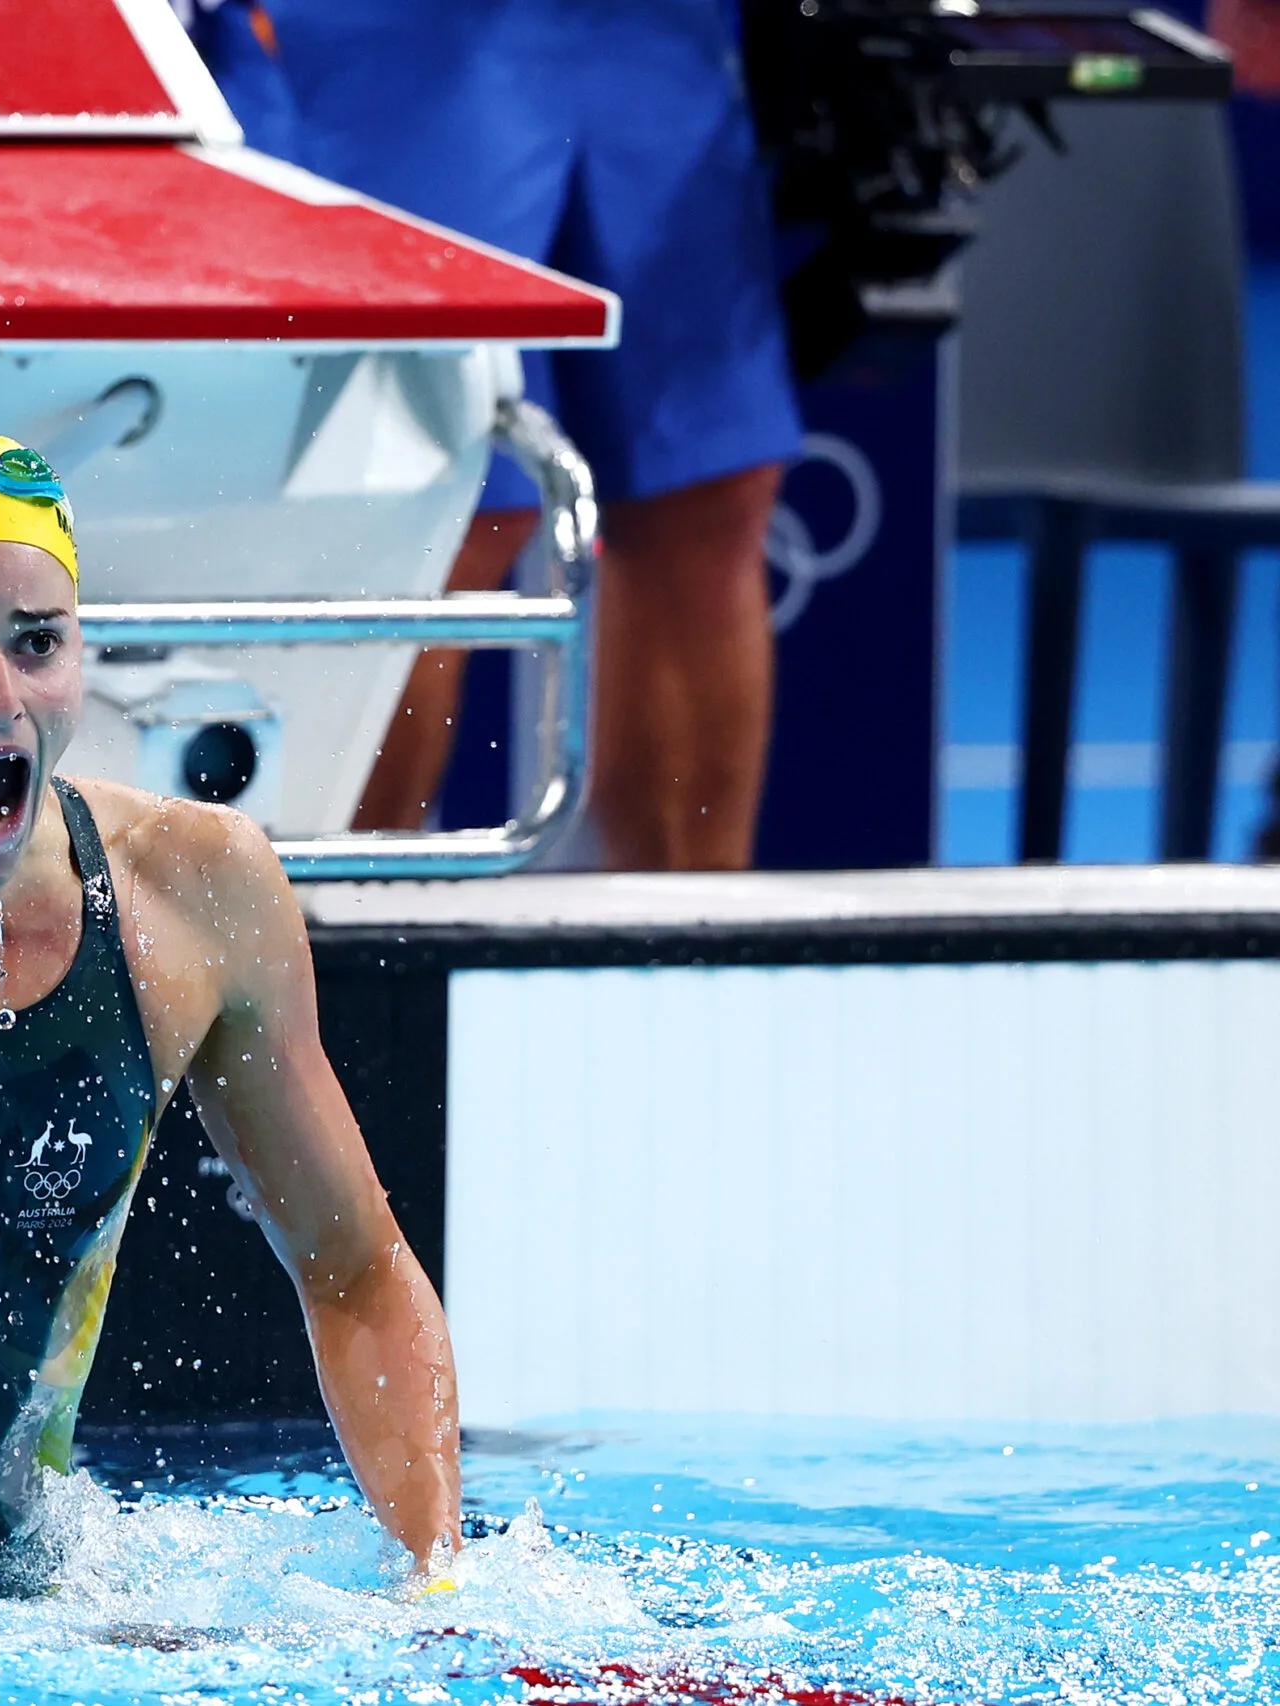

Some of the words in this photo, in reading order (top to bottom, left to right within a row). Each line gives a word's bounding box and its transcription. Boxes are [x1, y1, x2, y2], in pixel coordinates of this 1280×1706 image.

[18, 1207, 76, 1218] AUSTRALIA
[16, 1220, 46, 1229] PARIS
[47, 1218, 73, 1228] 2024
